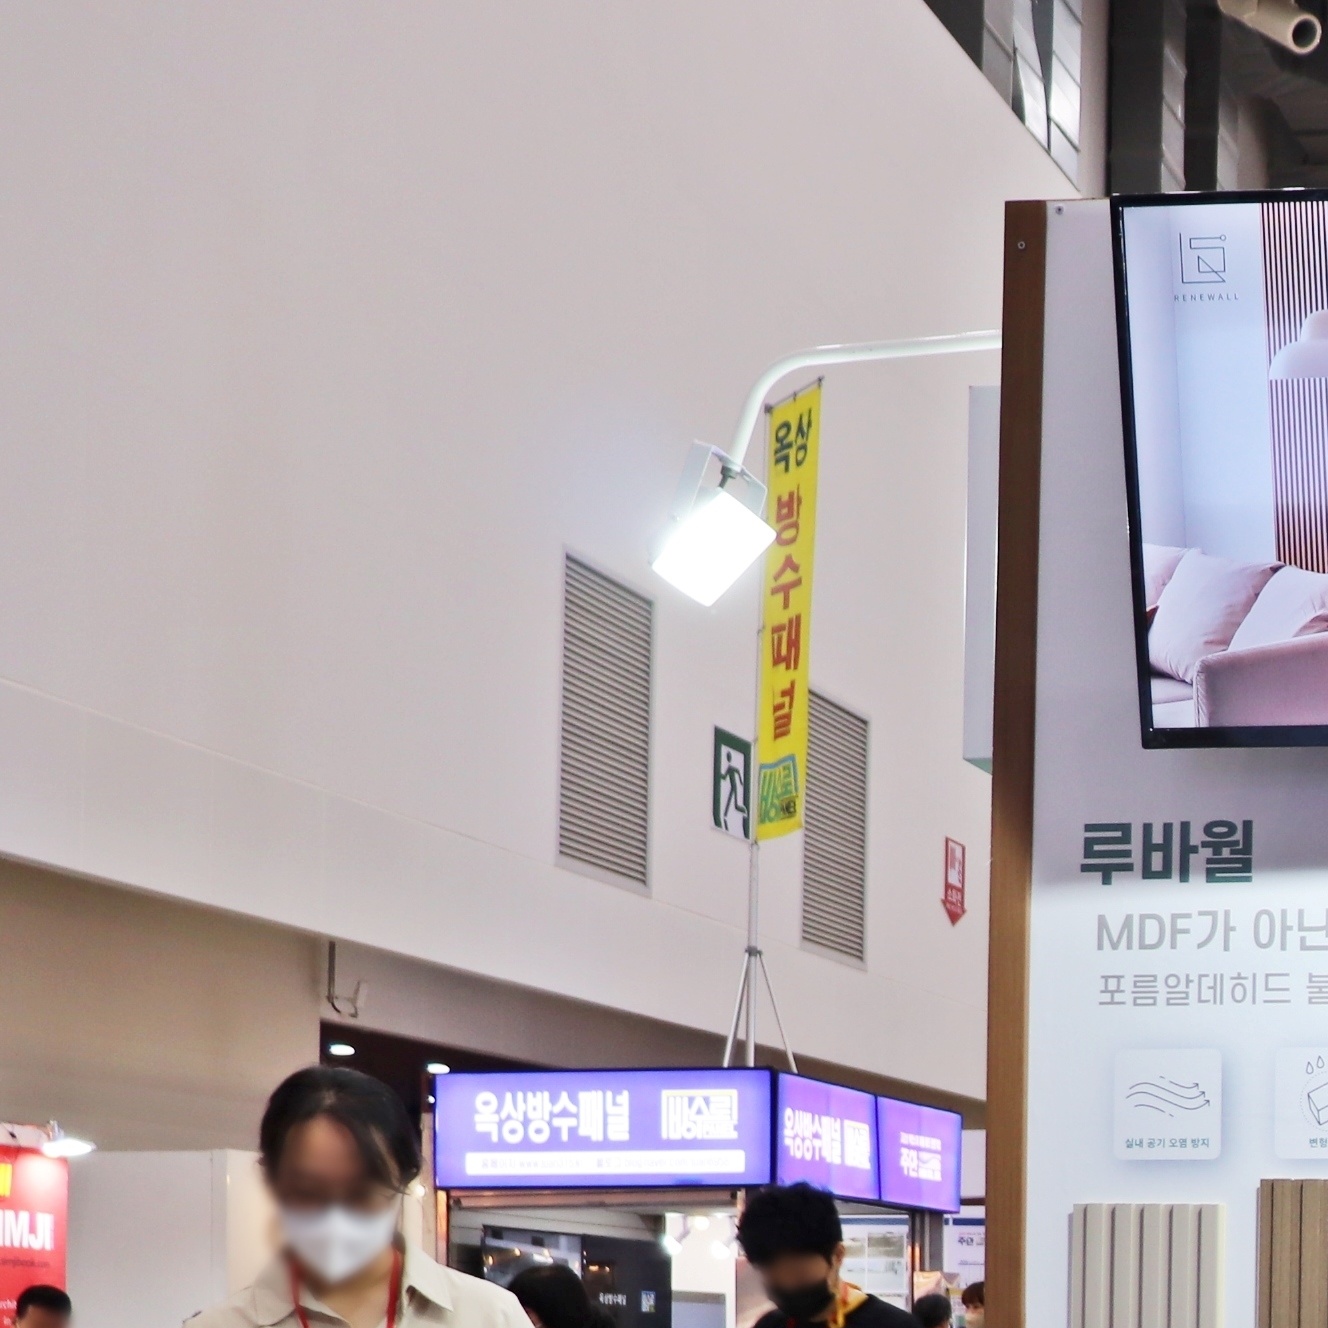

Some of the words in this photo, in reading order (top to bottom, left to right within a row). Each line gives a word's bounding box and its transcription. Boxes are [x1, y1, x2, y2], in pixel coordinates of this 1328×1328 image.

[1174, 292, 1240, 302] RENEWALL
[773, 405, 813, 475] 옥상
[770, 485, 803, 741] 방수패널
[1080, 819, 1255, 886] 루바월
[1096, 909, 1237, 952] MDF가
[1098, 971, 1293, 1007] 포름알데히드
[473, 1089, 630, 1145] 옥상방수패널
[784, 1107, 842, 1165] 옥상방수패널
[1125, 1137, 1145, 1149] 실내
[1146, 1137, 1167, 1149] 공기
[1168, 1137, 1189, 1149] 오염
[1190, 1137, 1210, 1149] 방지
